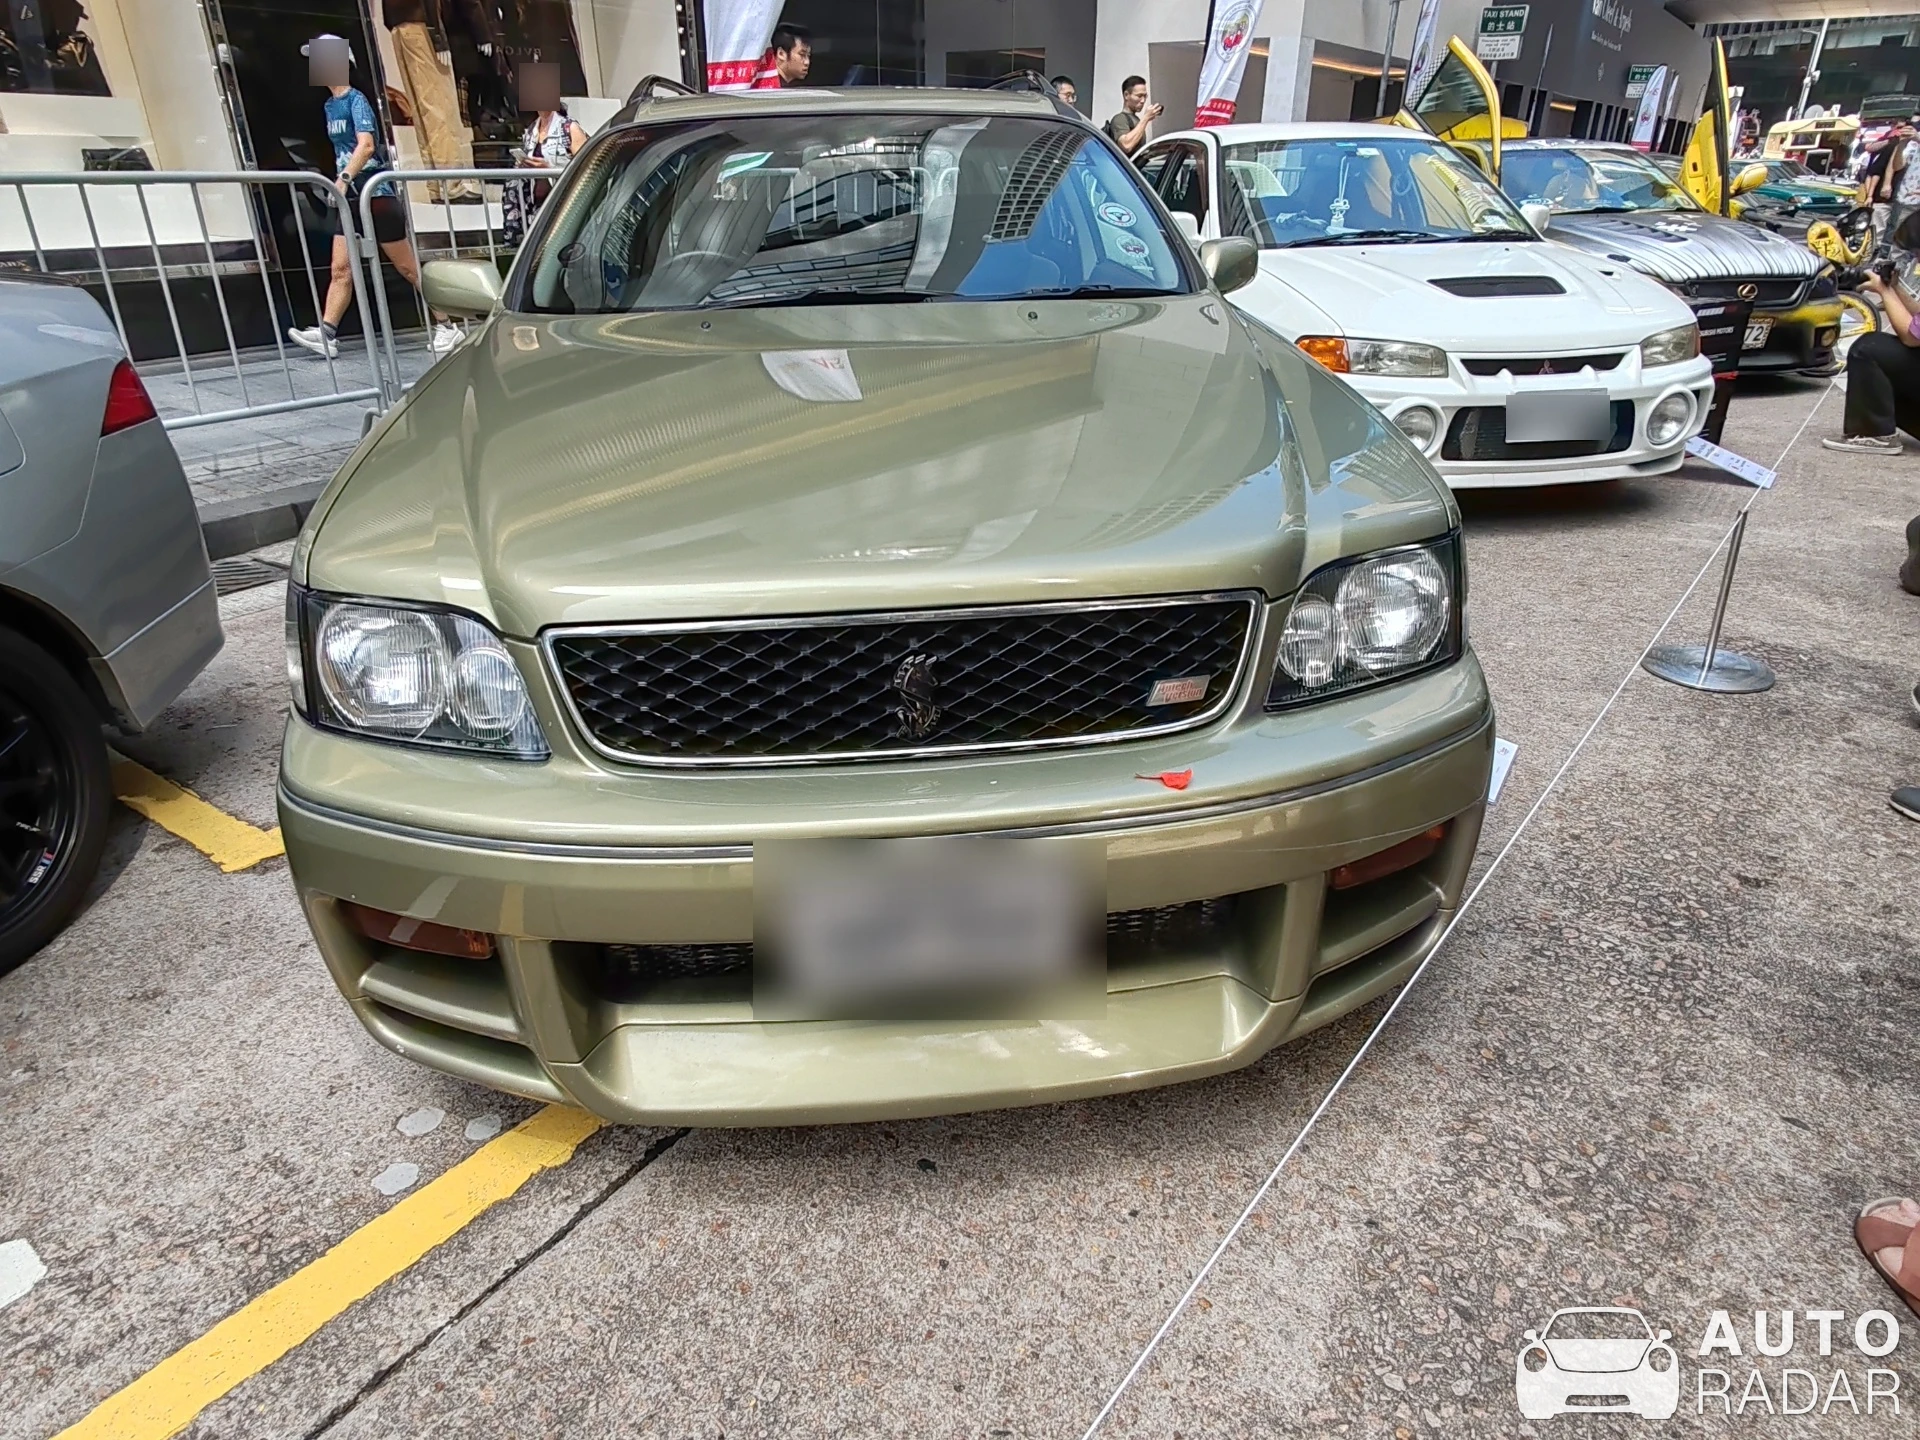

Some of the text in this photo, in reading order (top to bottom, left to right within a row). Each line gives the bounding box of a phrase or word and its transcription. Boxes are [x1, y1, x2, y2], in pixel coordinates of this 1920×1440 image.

[1484, 9, 1525, 18] TAXI STAND
[1487, 20, 1515, 31] 的士站
[1745, 325, 1764, 341] 72
[28, 865, 47, 884] SSR
